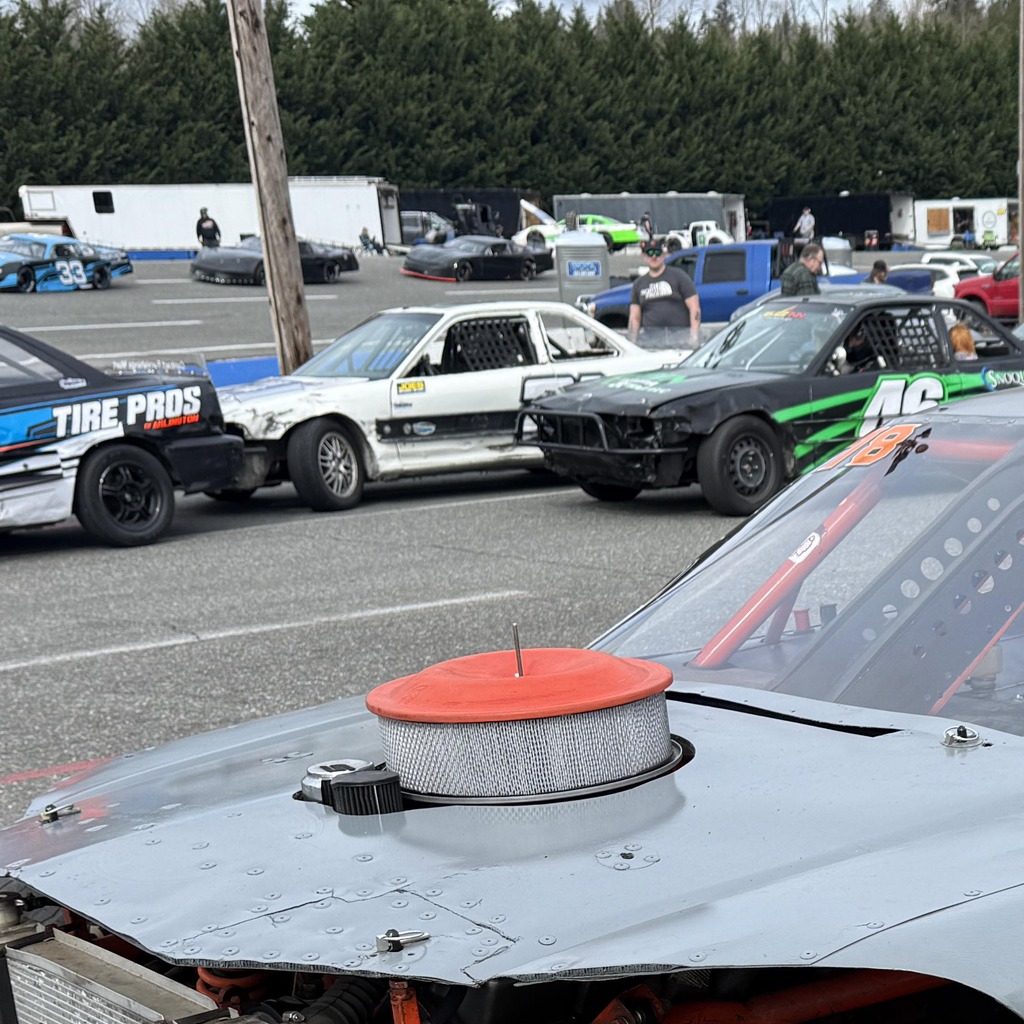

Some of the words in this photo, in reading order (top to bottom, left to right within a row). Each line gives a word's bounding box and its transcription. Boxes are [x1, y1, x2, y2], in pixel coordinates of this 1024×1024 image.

[55, 260, 87, 286] 33
[52, 397, 120, 438] TIRE
[126, 385, 202, 425] PROS
